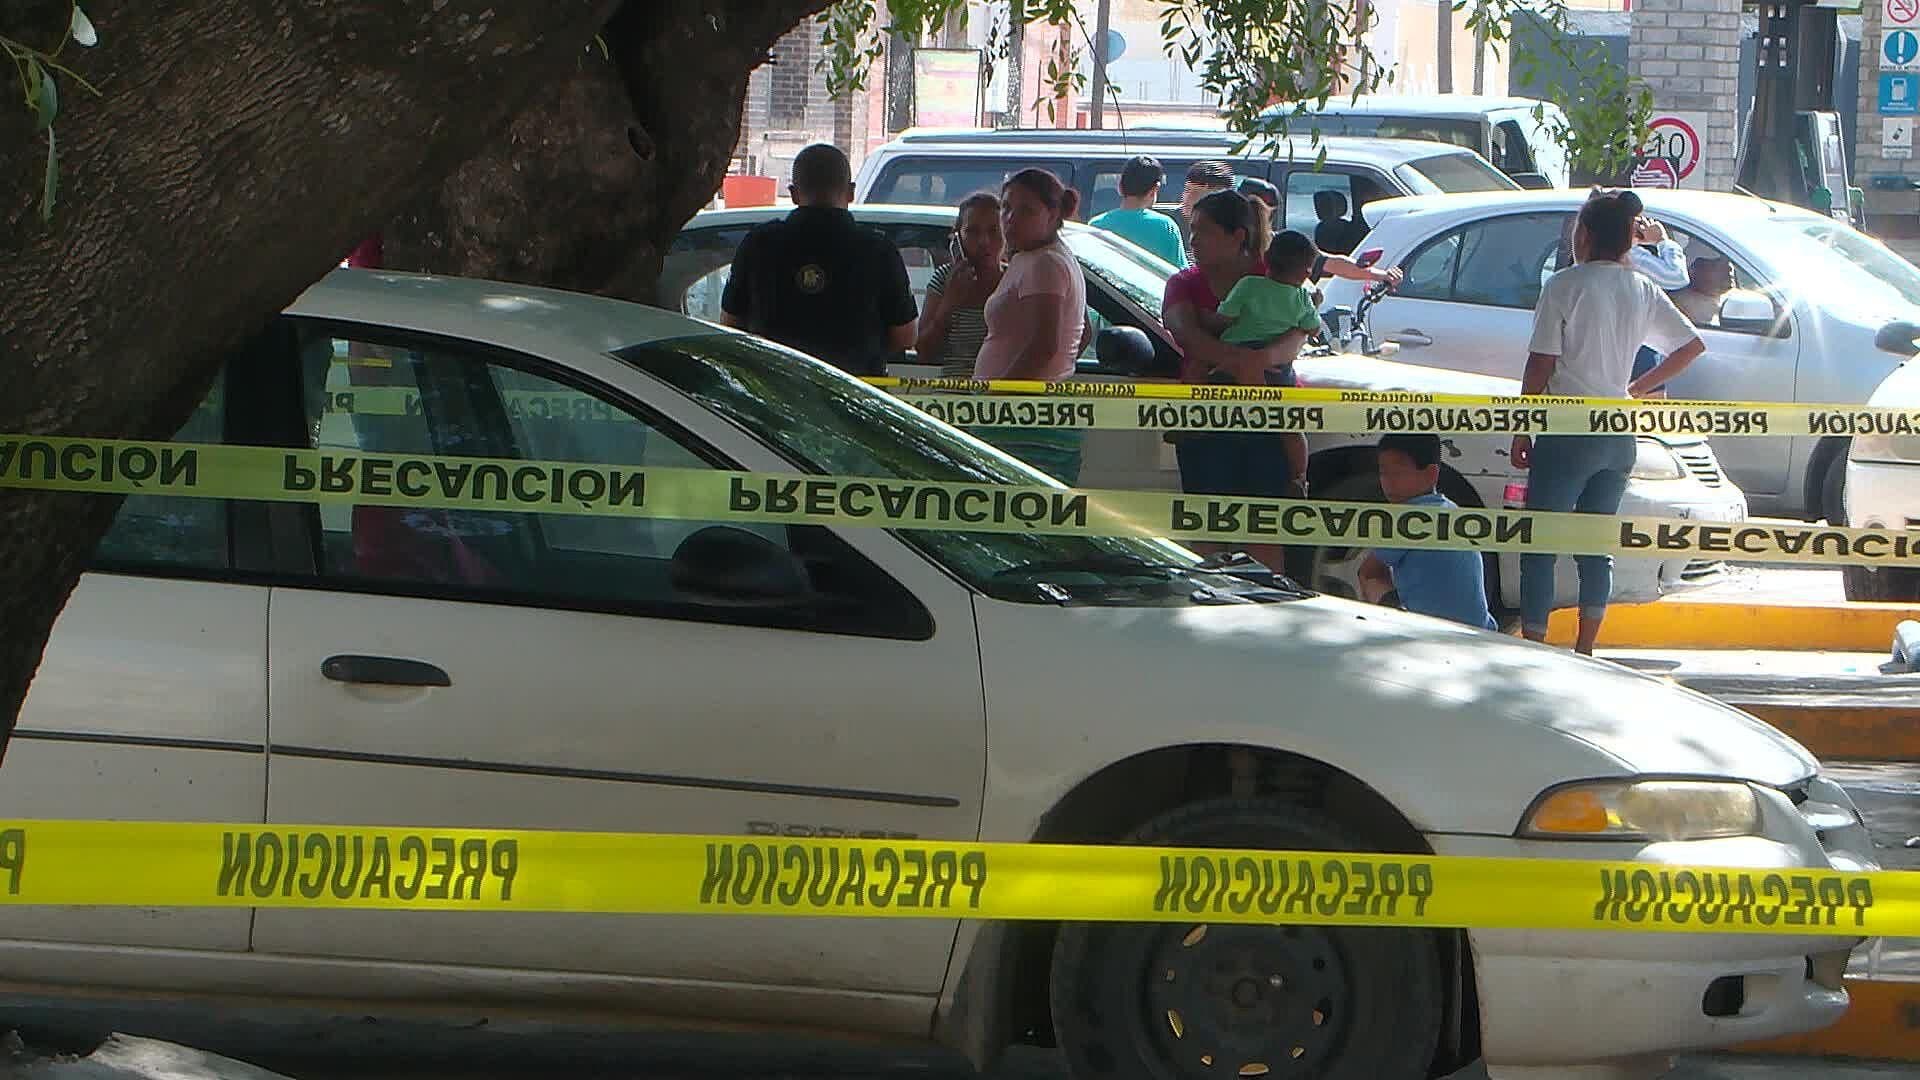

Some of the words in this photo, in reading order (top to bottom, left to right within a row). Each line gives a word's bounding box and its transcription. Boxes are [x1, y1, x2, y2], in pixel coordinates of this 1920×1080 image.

[1653, 132, 1685, 158] 10
[1045, 382, 1136, 397] PRECAUCION
[1191, 387, 1282, 400] PRECAUCION
